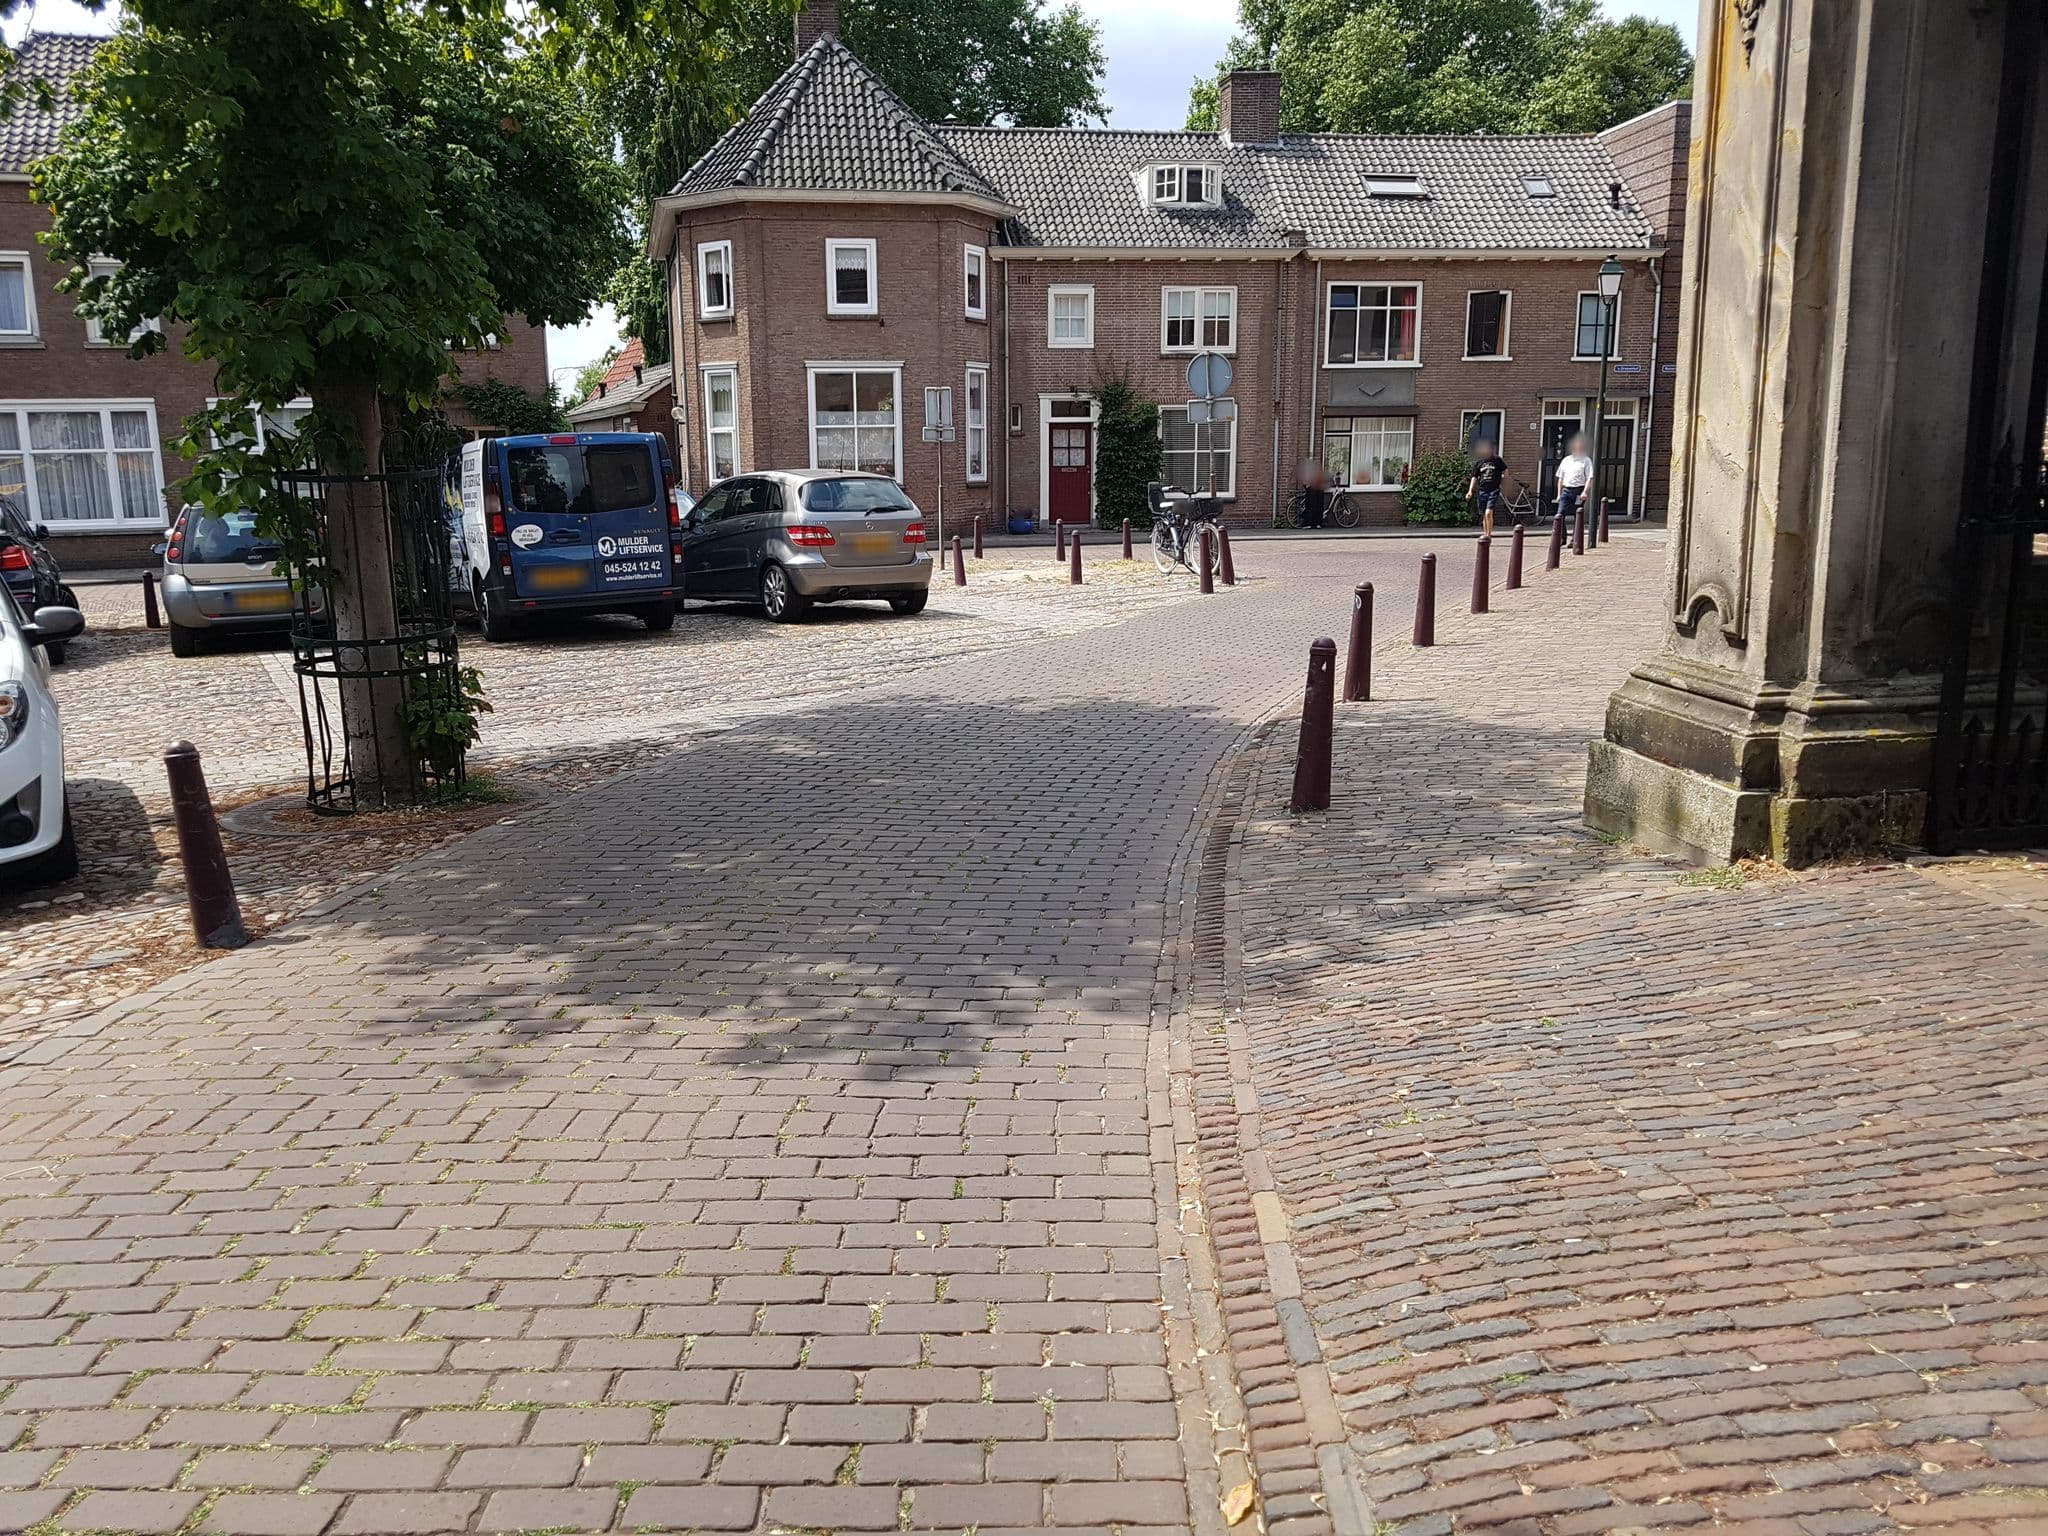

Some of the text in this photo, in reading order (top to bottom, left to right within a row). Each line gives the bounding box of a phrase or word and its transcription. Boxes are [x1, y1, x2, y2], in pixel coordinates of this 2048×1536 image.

[618, 536, 648, 545] MULDER
[619, 544, 664, 555] LIFTSERVICE
[604, 560, 661, 573] 045-524 12 42
